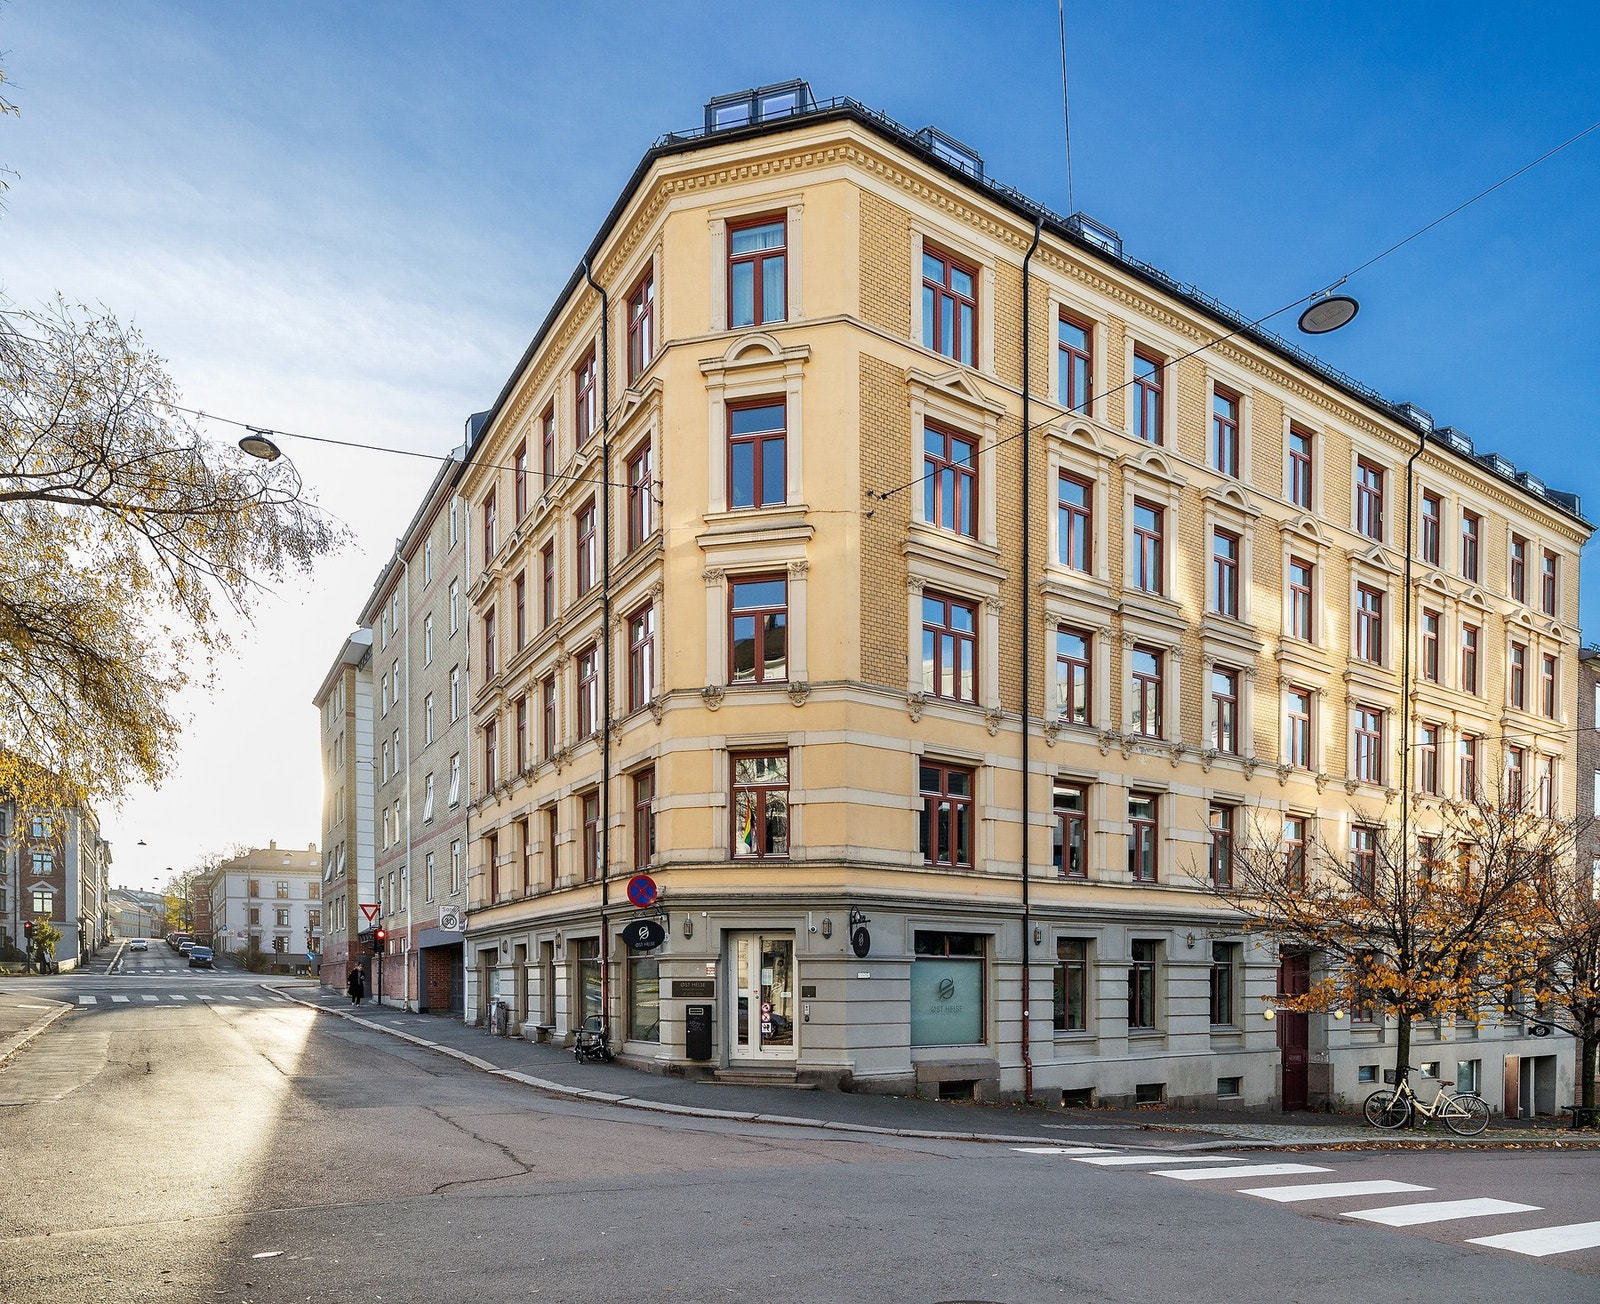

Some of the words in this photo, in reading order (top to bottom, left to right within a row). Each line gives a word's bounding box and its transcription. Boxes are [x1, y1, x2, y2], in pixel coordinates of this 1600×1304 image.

[445, 918, 455, 926] 30
[931, 1005, 943, 1013] ØST
[945, 1005, 962, 1013] HELSE
